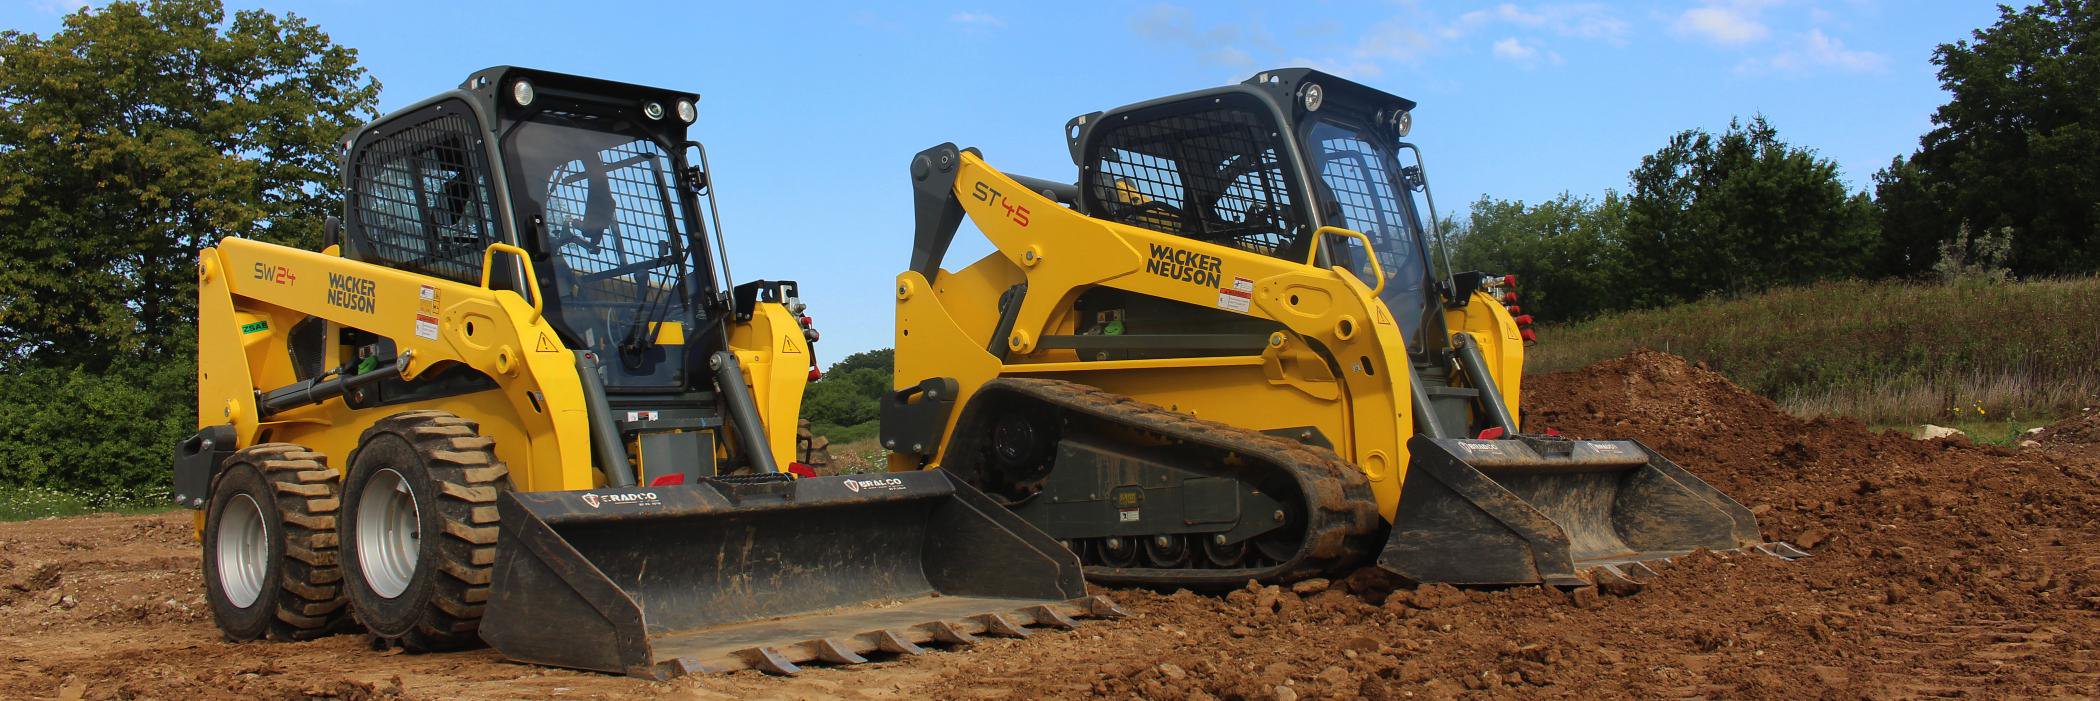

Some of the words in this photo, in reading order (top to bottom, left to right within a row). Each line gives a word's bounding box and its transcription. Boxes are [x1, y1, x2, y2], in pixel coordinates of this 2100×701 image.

[1149, 243, 1222, 273] WACKER
[254, 262, 296, 286] SW24
[329, 272, 376, 297] WACKER
[1146, 258, 1221, 289] NEUSON
[327, 288, 376, 315] NEUSON
